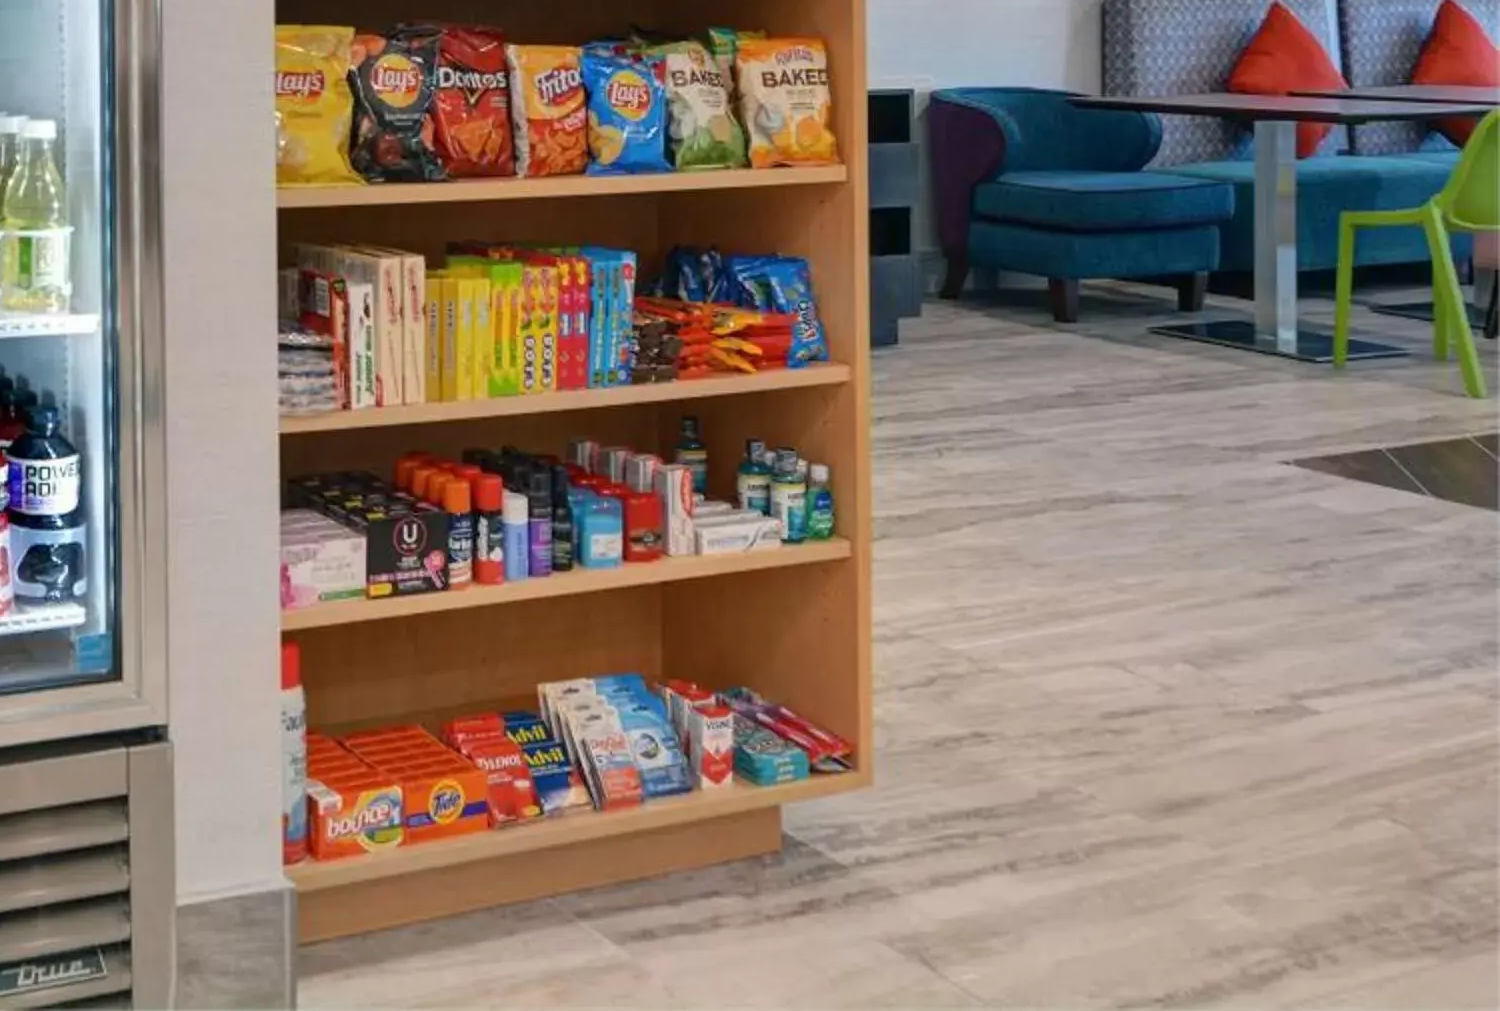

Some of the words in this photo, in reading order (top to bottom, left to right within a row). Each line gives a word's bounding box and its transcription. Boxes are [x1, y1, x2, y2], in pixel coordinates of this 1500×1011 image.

[371, 65, 417, 94] Lay's
[438, 67, 507, 89] Doritos
[762, 69, 828, 88] BAKED
[610, 80, 649, 108] Lay's
[403, 523, 418, 543] U
[507, 725, 546, 744] Advil
[476, 755, 522, 770] TYLENOL
[524, 748, 565, 767] Advil
[434, 792, 461, 817] Tide
[326, 803, 389, 837] bounce
